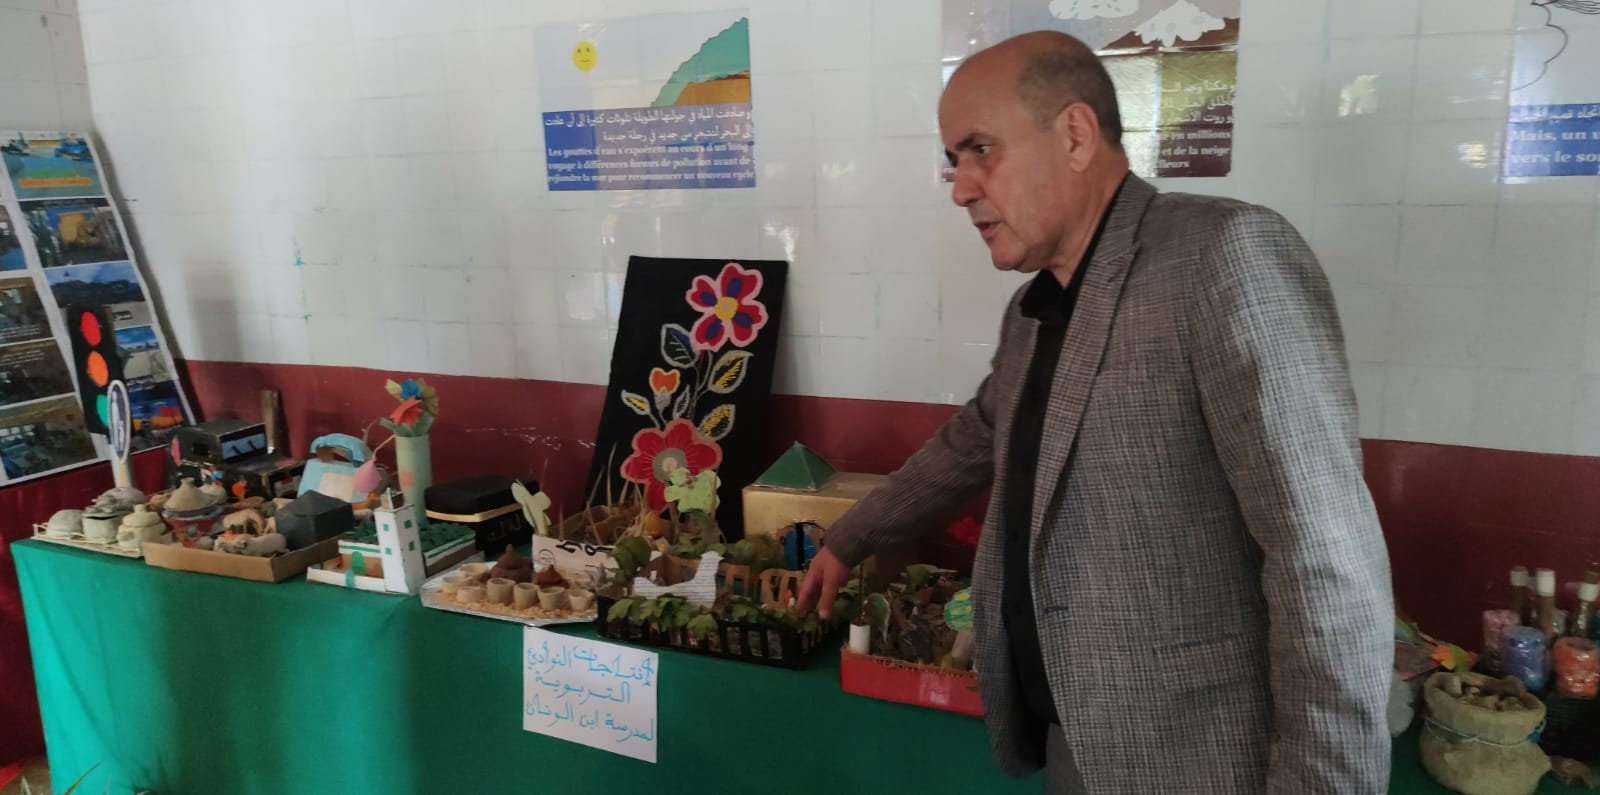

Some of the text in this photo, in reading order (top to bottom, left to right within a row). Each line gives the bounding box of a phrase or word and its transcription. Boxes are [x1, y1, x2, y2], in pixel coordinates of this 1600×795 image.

[687, 111, 697, 126] في
[1186, 129, 1231, 140] millions
[1560, 131, 1588, 140] un
[548, 147, 562, 157] Les
[1173, 145, 1188, 156] de
[1188, 145, 1199, 156] la
[1200, 145, 1231, 158] neige
[1554, 148, 1573, 162] le
[660, 157, 672, 168] de
[535, 671, 631, 705] التربوية
